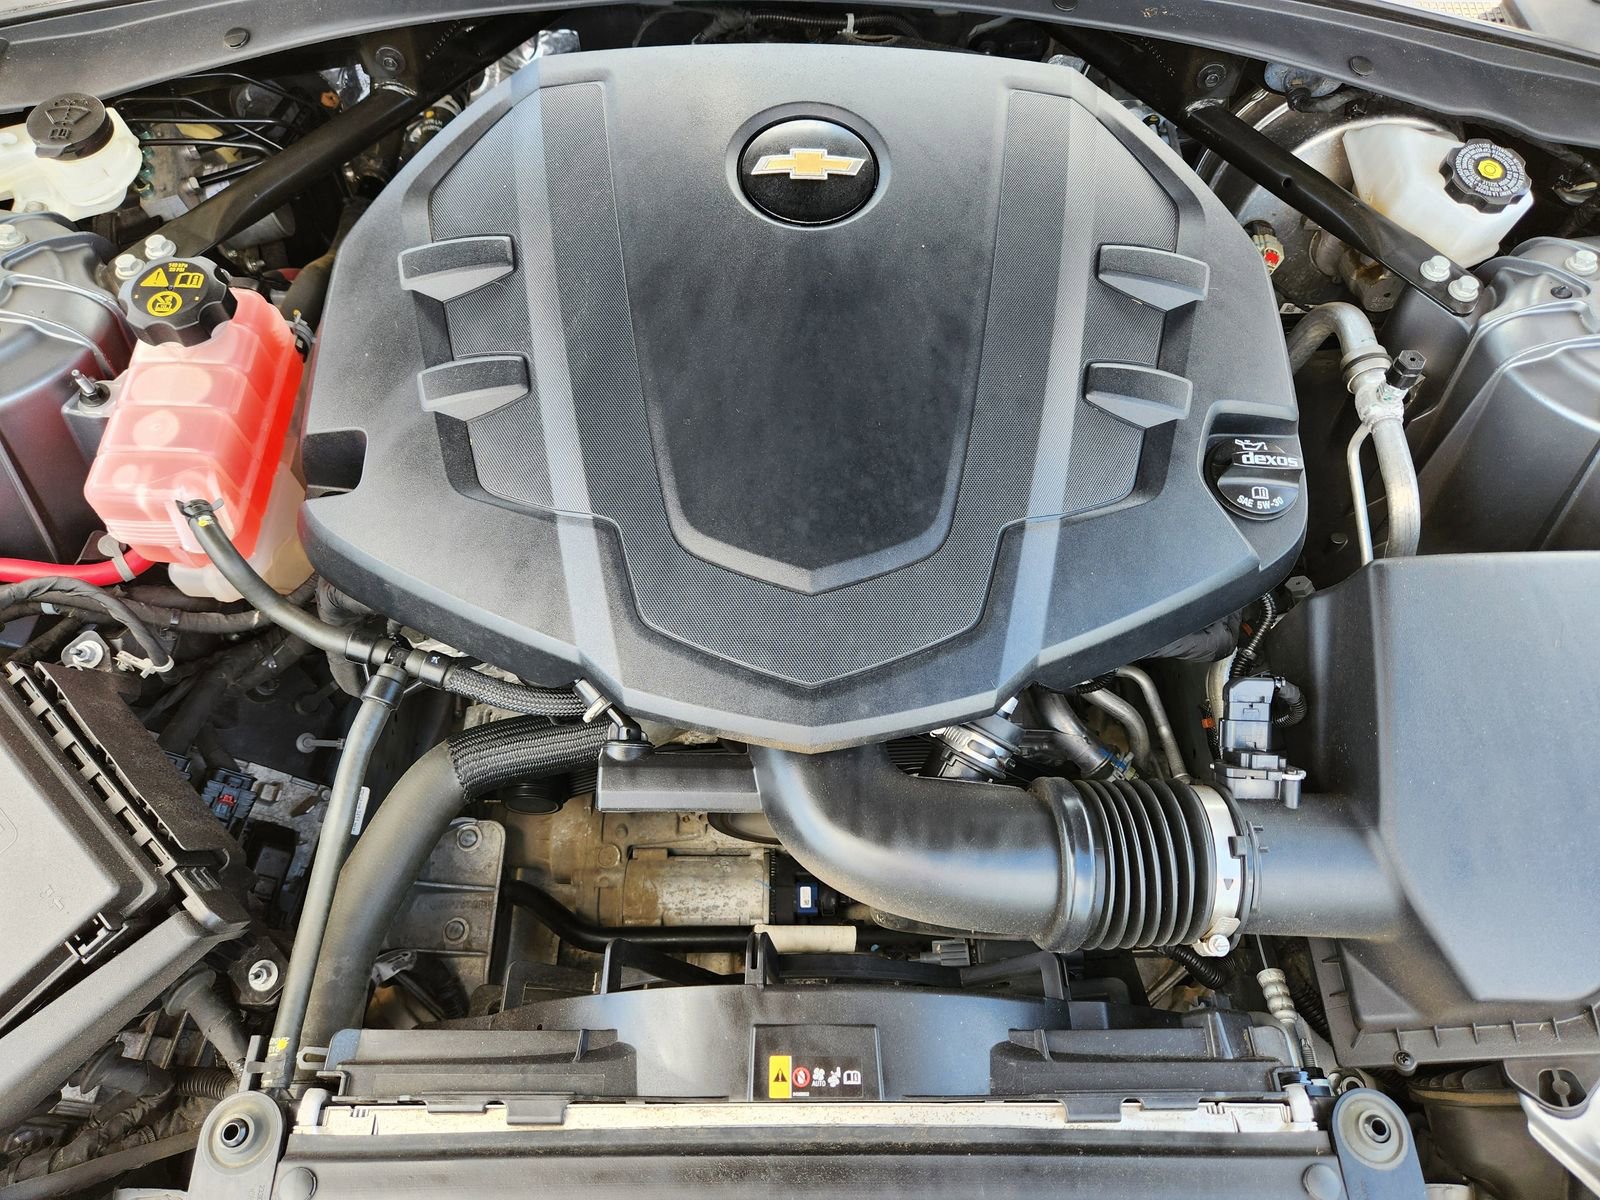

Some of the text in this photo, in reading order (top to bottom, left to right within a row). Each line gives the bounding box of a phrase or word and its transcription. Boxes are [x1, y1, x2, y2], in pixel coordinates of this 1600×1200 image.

[1241, 451, 1299, 467] dexos
[1236, 494, 1284, 509] SAE 5W-30
